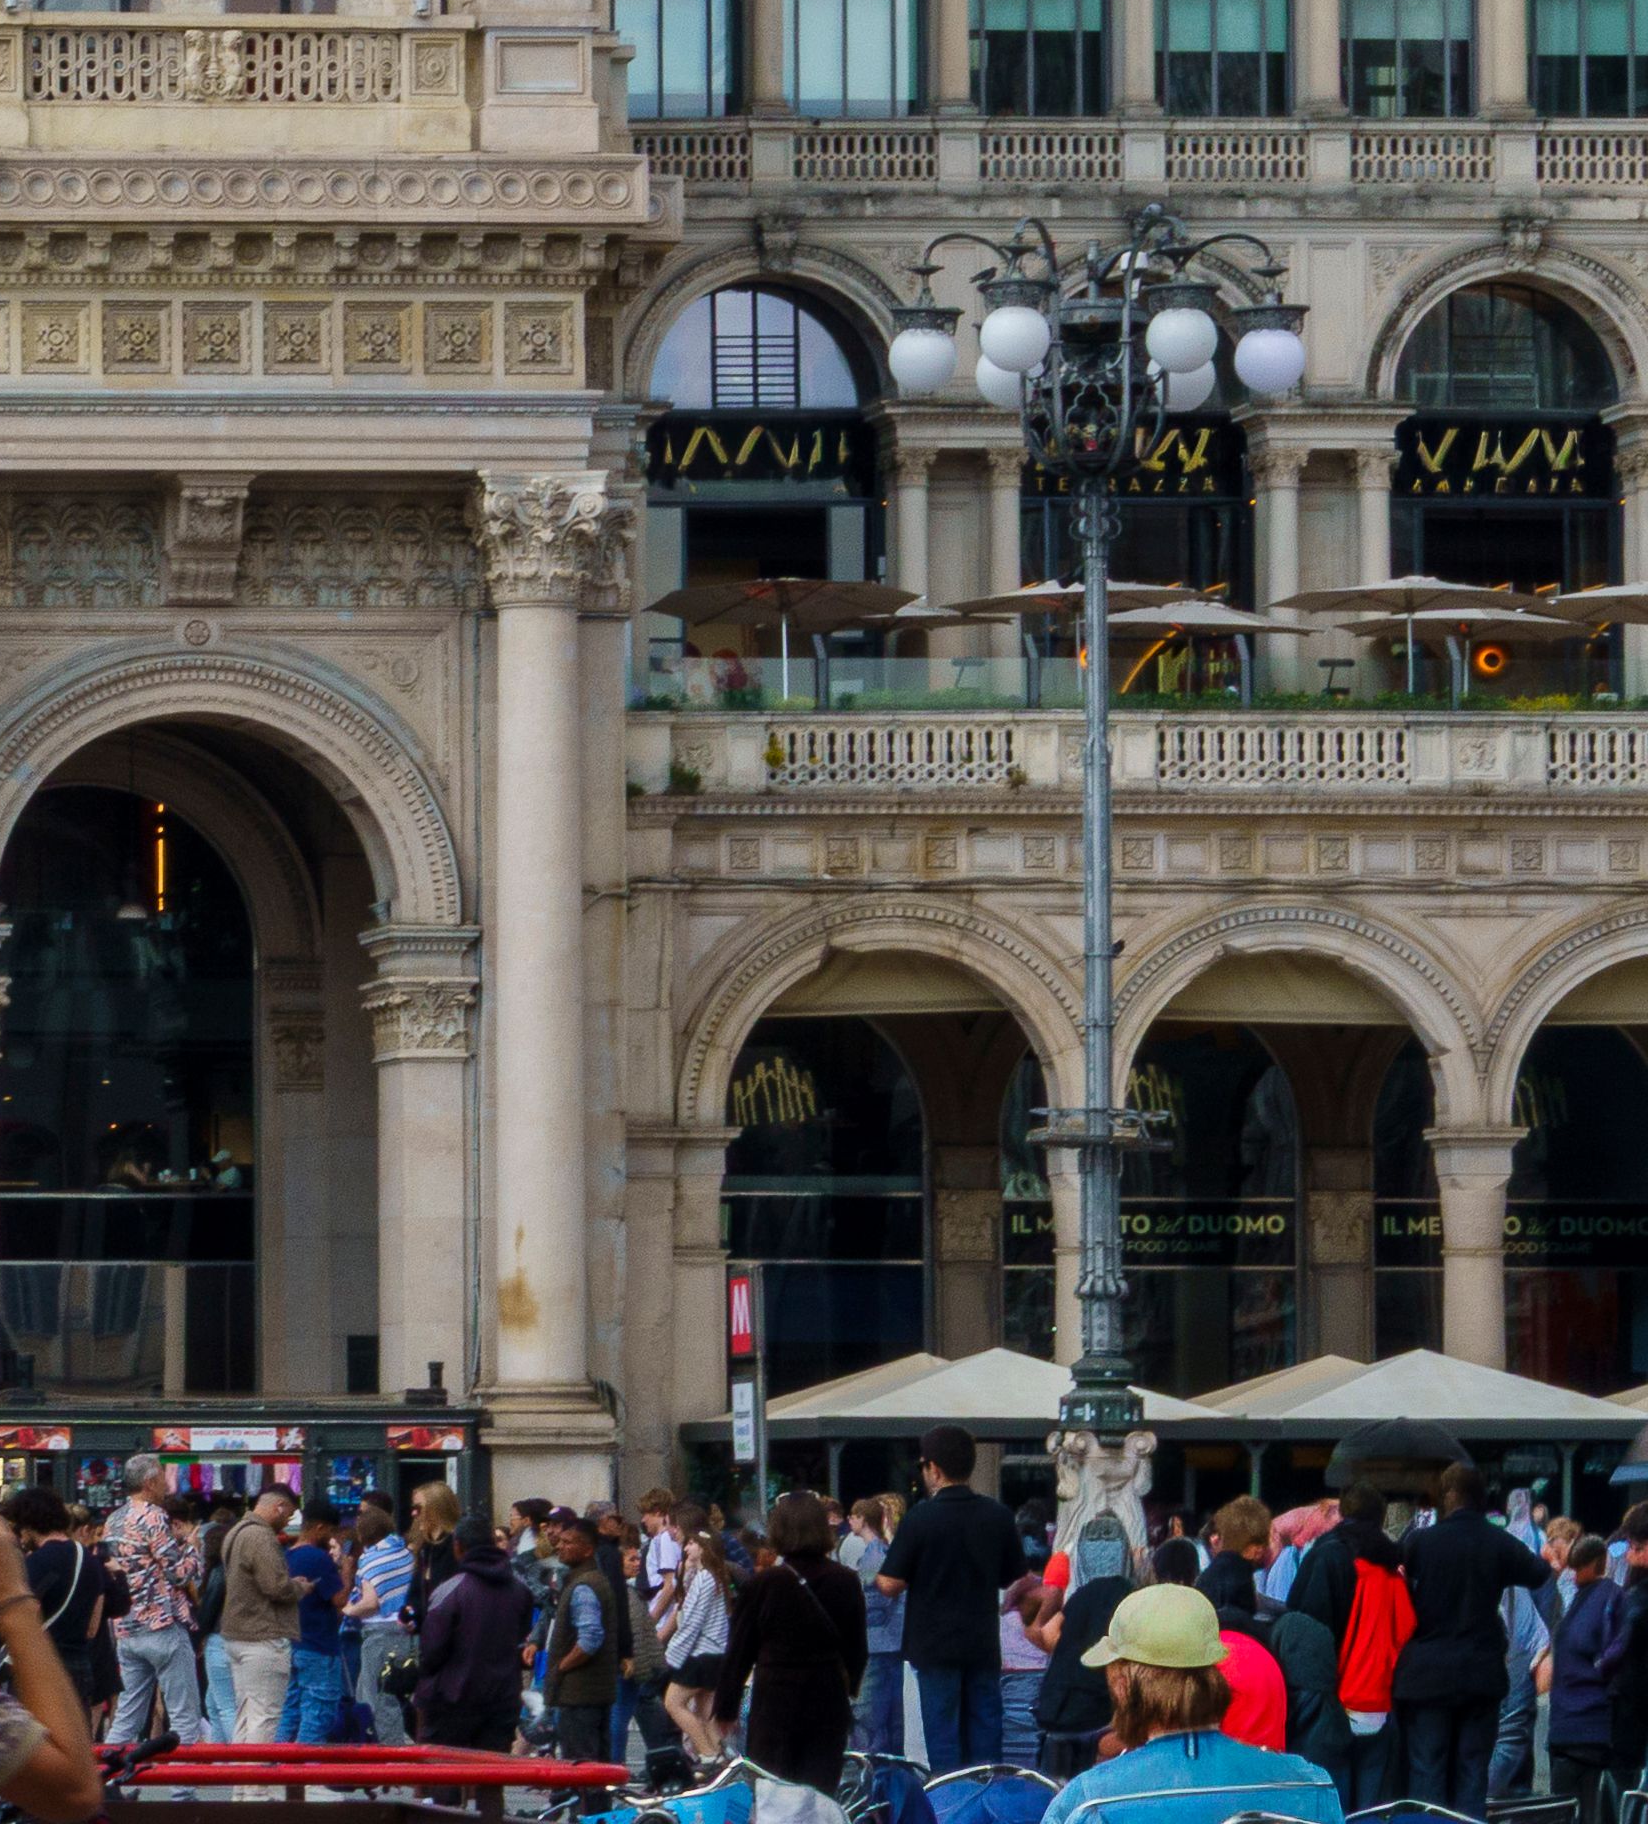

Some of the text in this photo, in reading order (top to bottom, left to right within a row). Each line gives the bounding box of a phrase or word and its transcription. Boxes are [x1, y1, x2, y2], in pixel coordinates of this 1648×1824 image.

[1010, 1214, 1033, 1235] IL
[1187, 1214, 1286, 1236] DUOMO
[1381, 1215, 1402, 1236] IL
[1126, 1239, 1222, 1253] FOOD SQUARE
[731, 1283, 751, 1336] M
